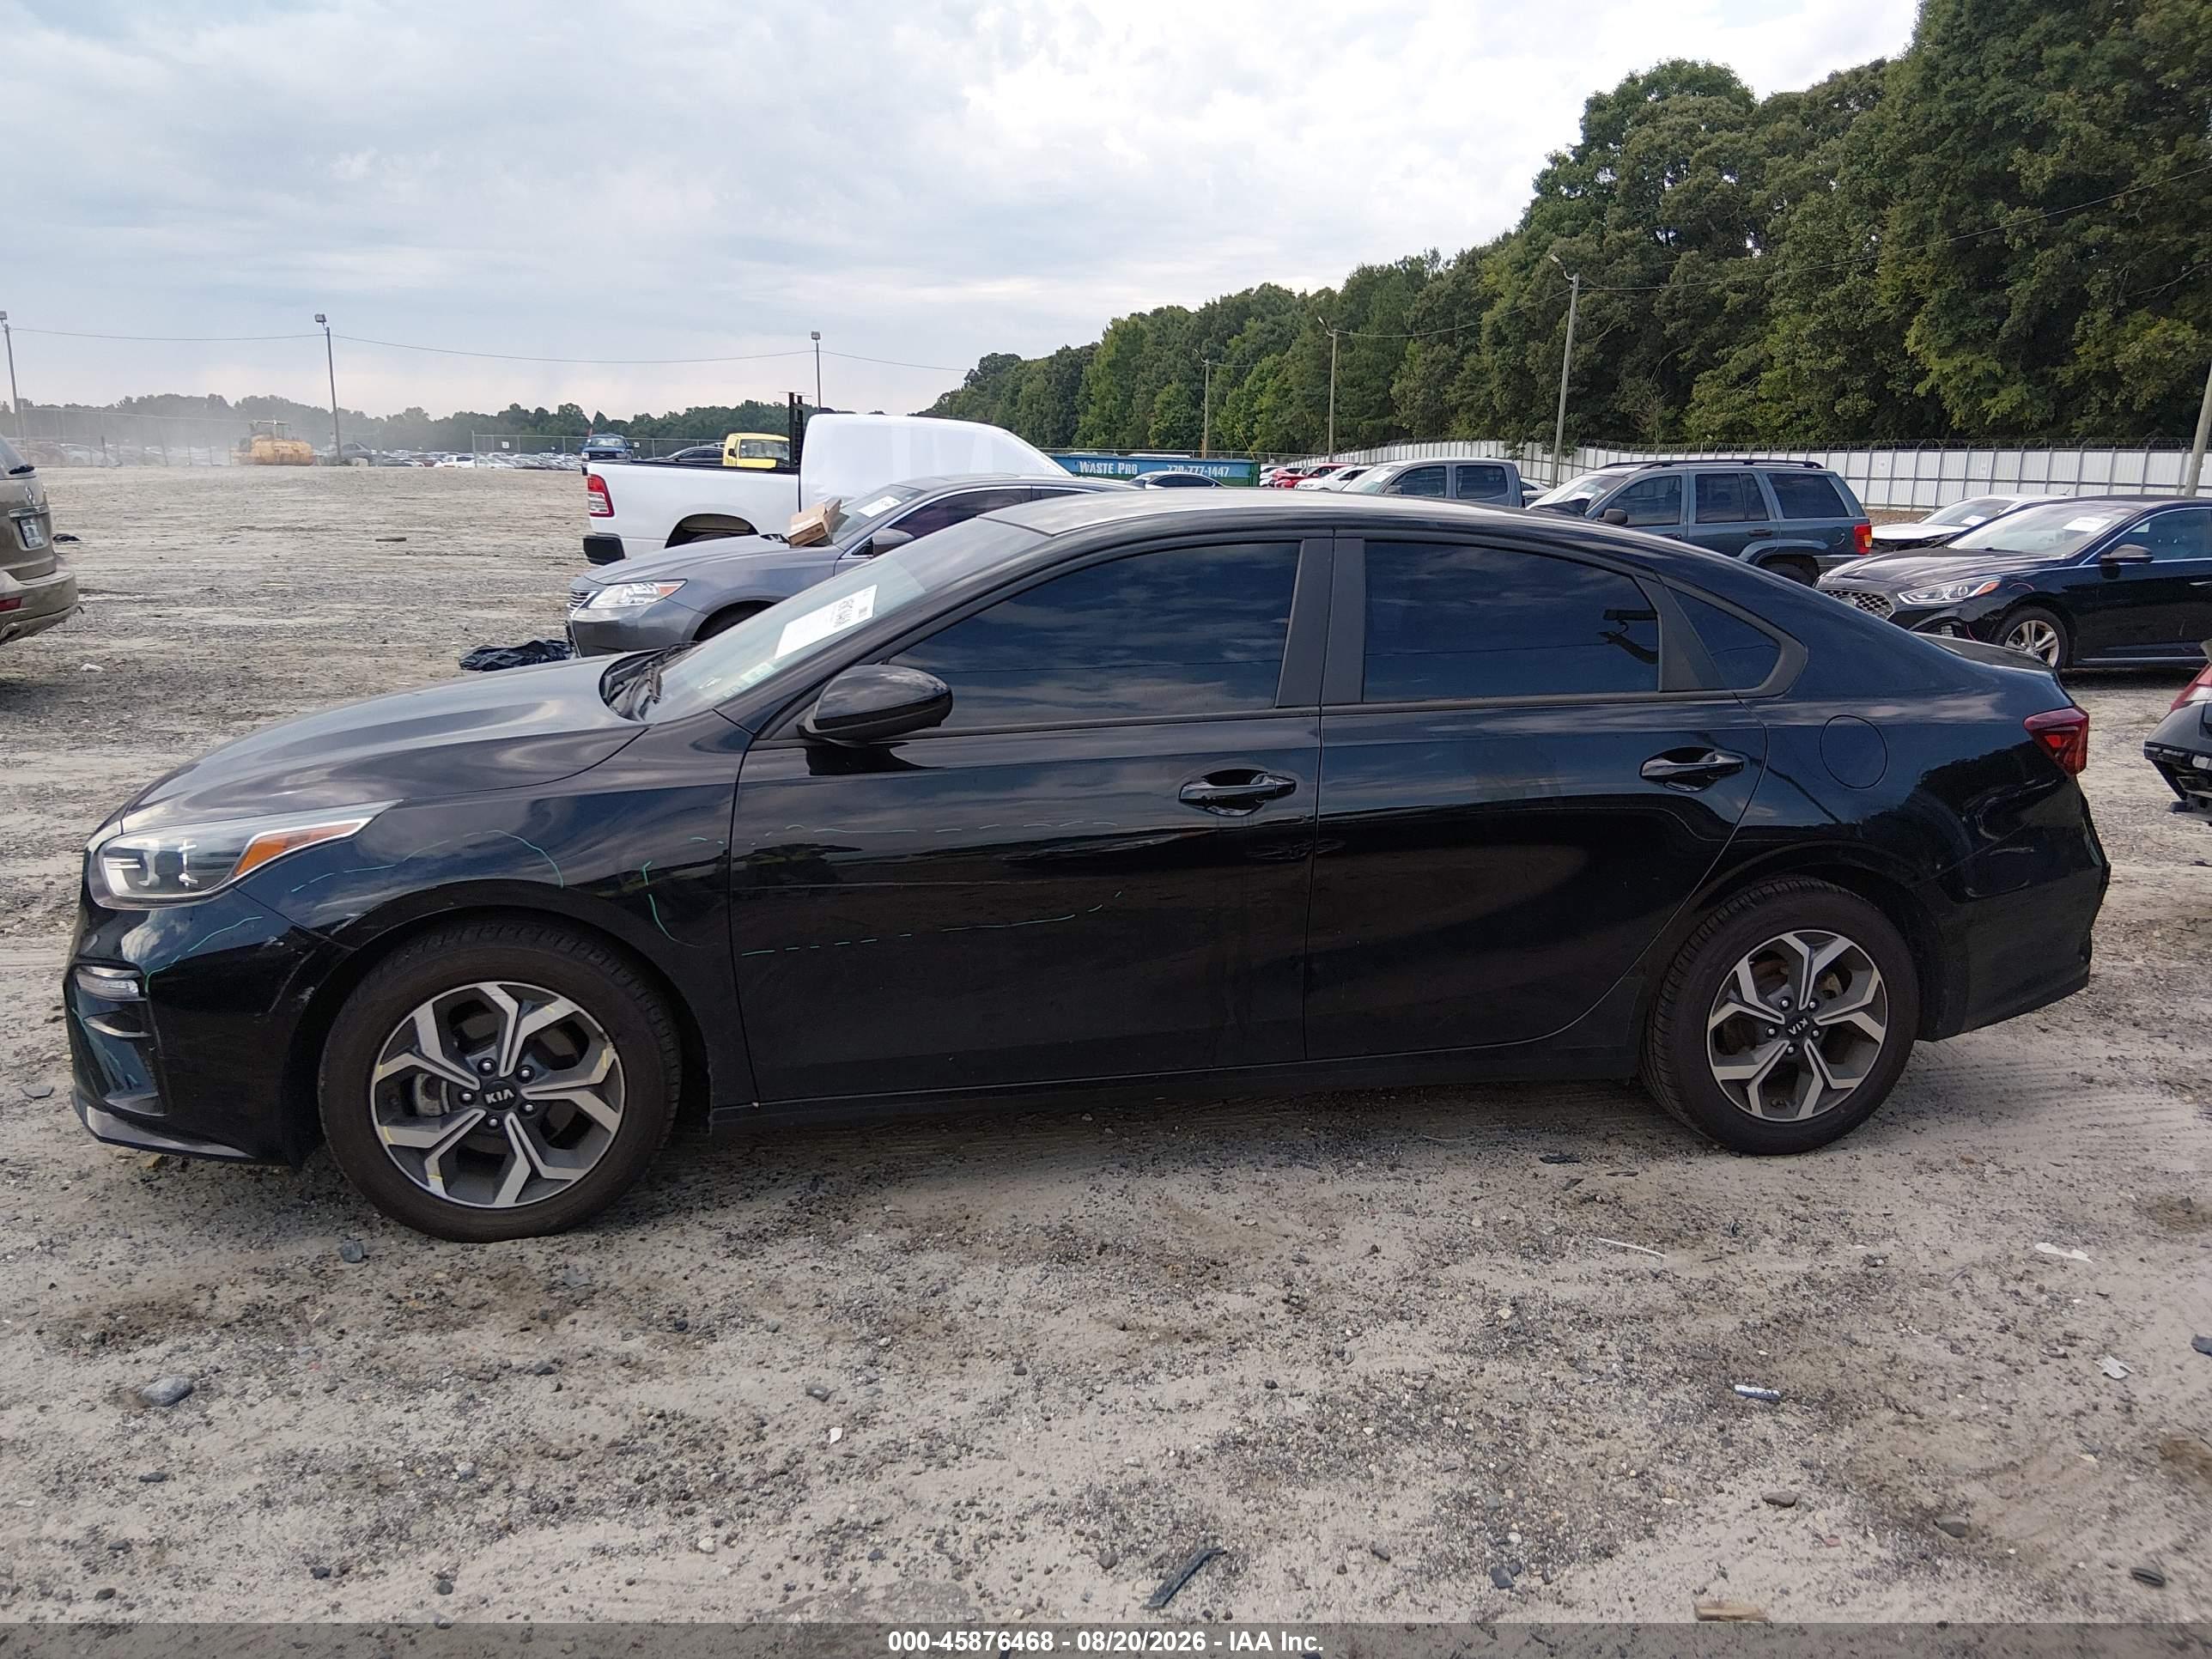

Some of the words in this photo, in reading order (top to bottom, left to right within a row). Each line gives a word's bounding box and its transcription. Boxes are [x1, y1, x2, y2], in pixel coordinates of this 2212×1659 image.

[1079, 460, 1115, 474] WASTE
[1118, 462, 1138, 475] PRO
[1167, 465, 1230, 477] 770-777-1447
[1788, 1018, 1808, 1035] KIA
[484, 1089, 515, 1104] KIA
